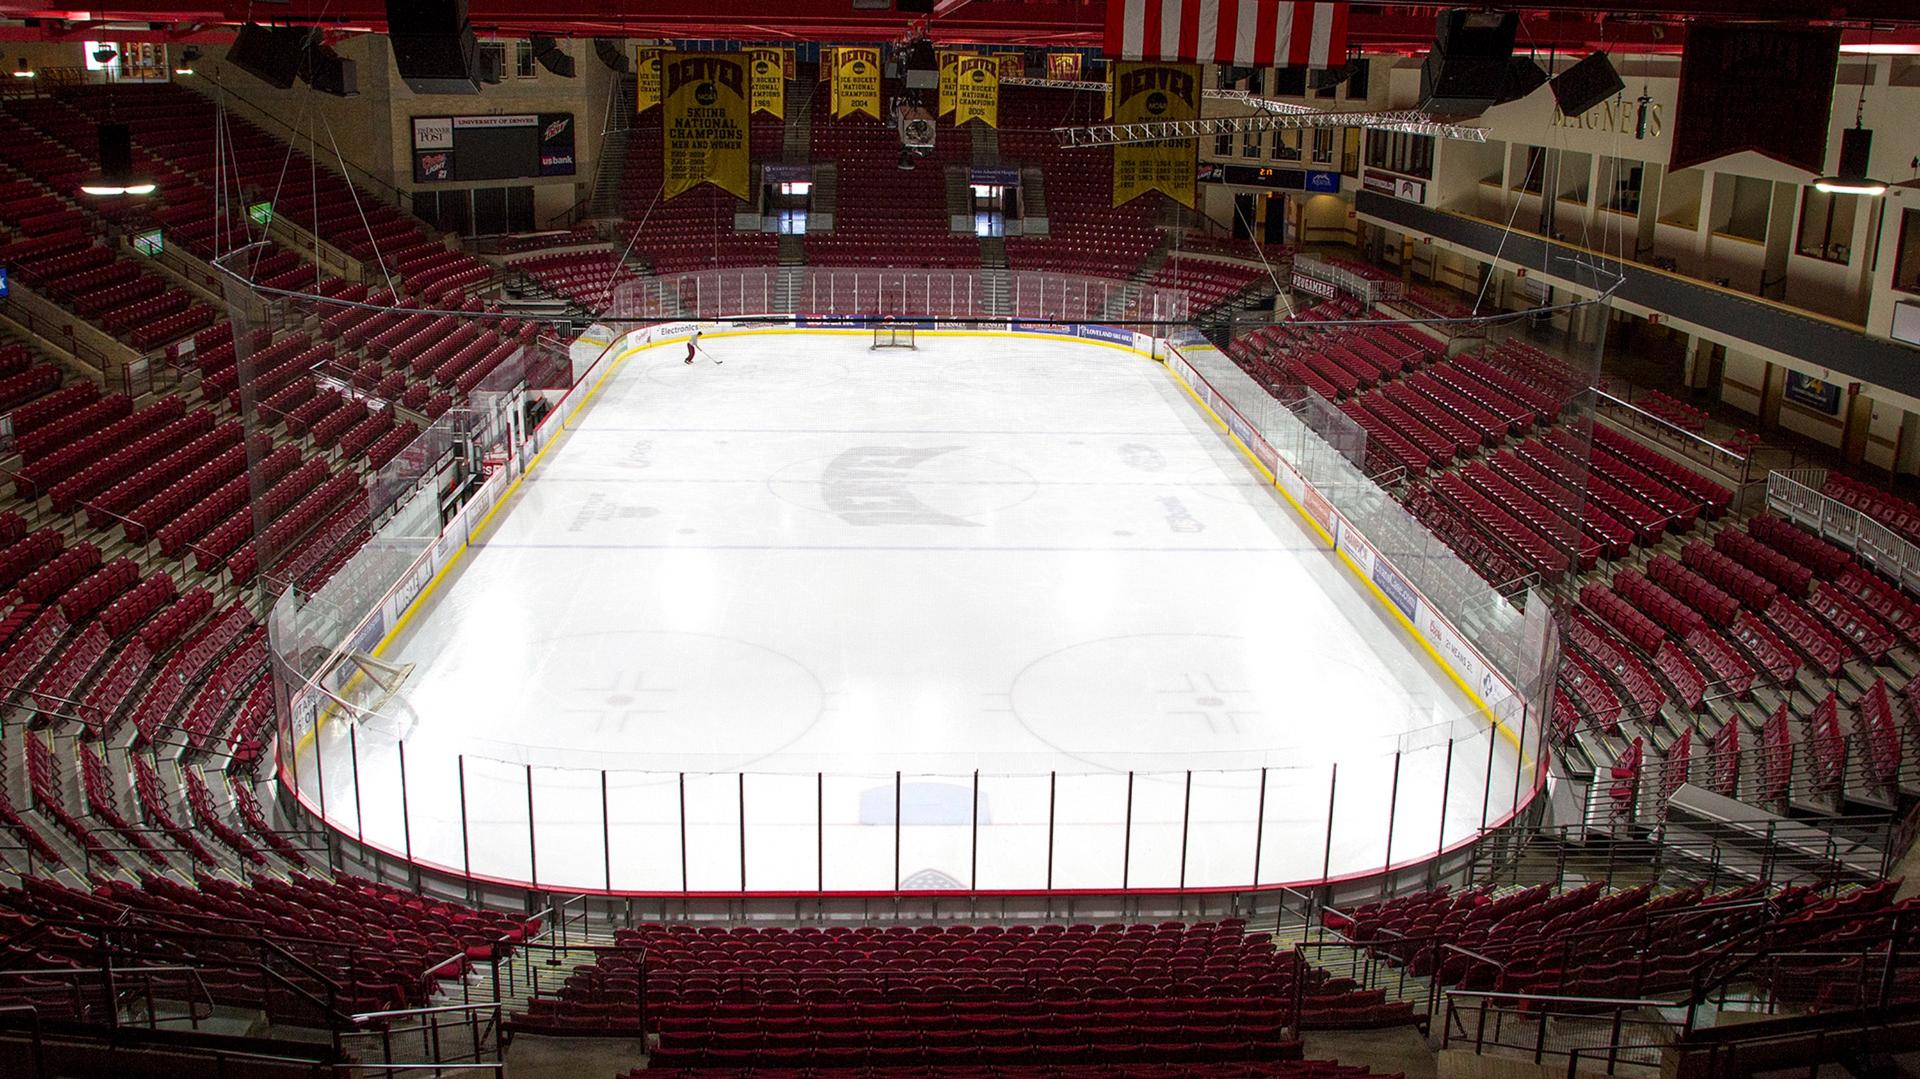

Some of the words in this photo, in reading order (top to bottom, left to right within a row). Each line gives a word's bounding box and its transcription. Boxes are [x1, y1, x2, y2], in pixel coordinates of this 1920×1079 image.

[841, 50, 877, 69] DENVER
[961, 58, 997, 79] DENVER
[668, 57, 744, 99] DENVER
[1119, 68, 1194, 109] DENVER
[687, 108, 725, 118] SKIING
[1552, 100, 1663, 137] MGNES
[675, 118, 738, 129] NATIONAL
[420, 133, 444, 142] POST
[669, 129, 743, 140] CHAMPIONS
[691, 140, 708, 149] AND
[661, 325, 699, 336] Electronics
[1086, 328, 1113, 338] LOVELAND
